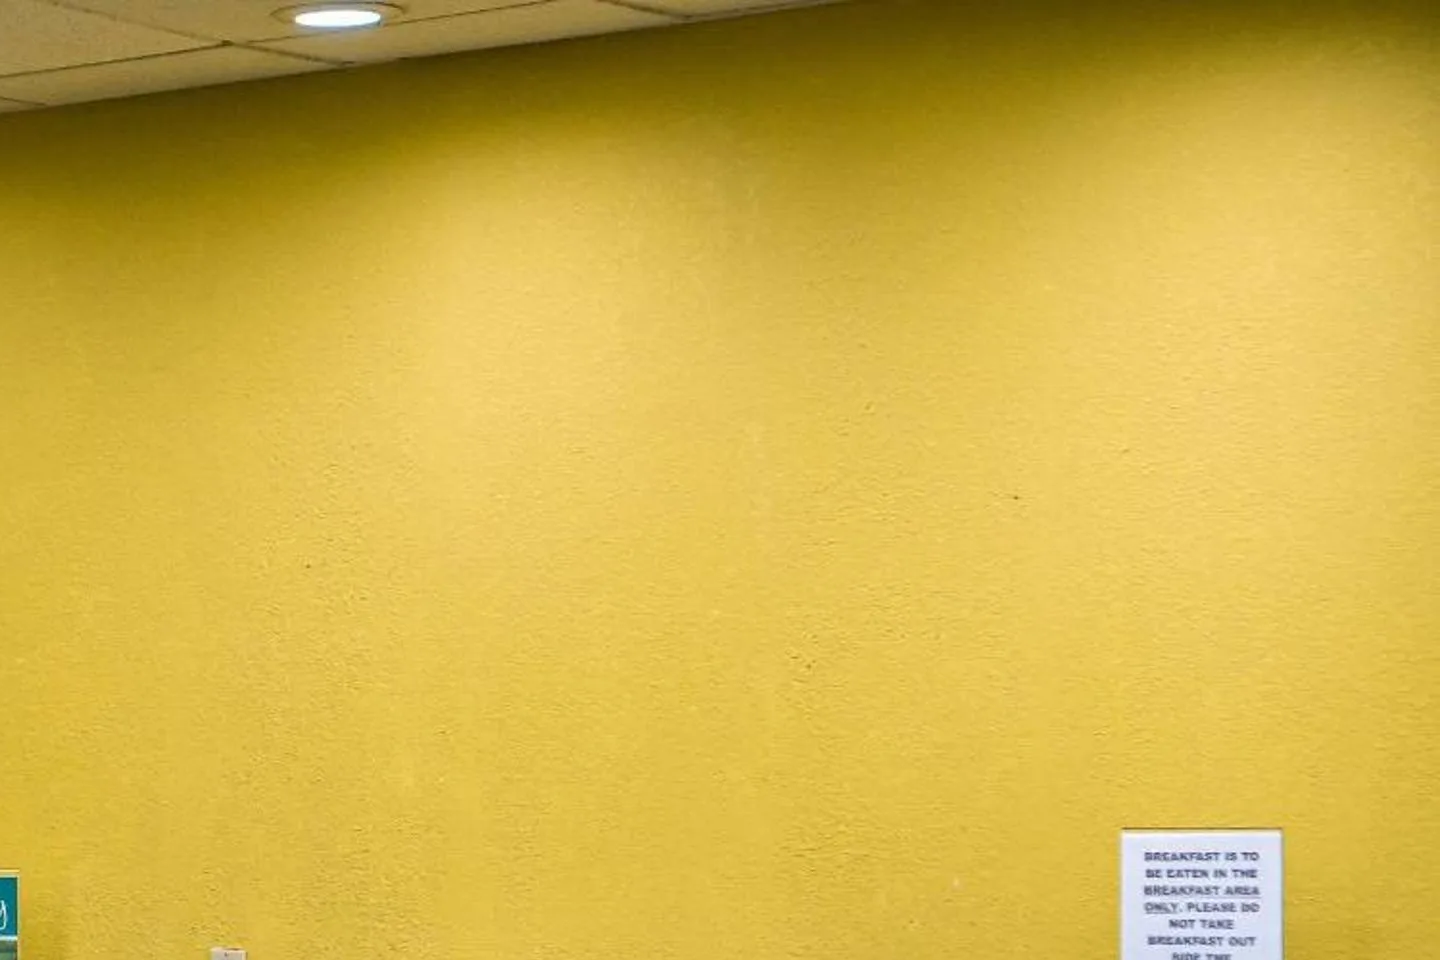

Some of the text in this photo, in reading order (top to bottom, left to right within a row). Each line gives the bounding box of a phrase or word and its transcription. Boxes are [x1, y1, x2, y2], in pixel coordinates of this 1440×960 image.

[1144, 852, 1260, 862] BREAKFAST IS TO
[1145, 869, 1258, 878] BE EATEN IN THE
[1144, 885, 1260, 896] BREAKFAST AREA
[1144, 902, 1260, 913] ONLY. PLEASE DO
[1169, 919, 1235, 929] NOT TAKE
[1147, 936, 1257, 946] BREAKFAST OUT
